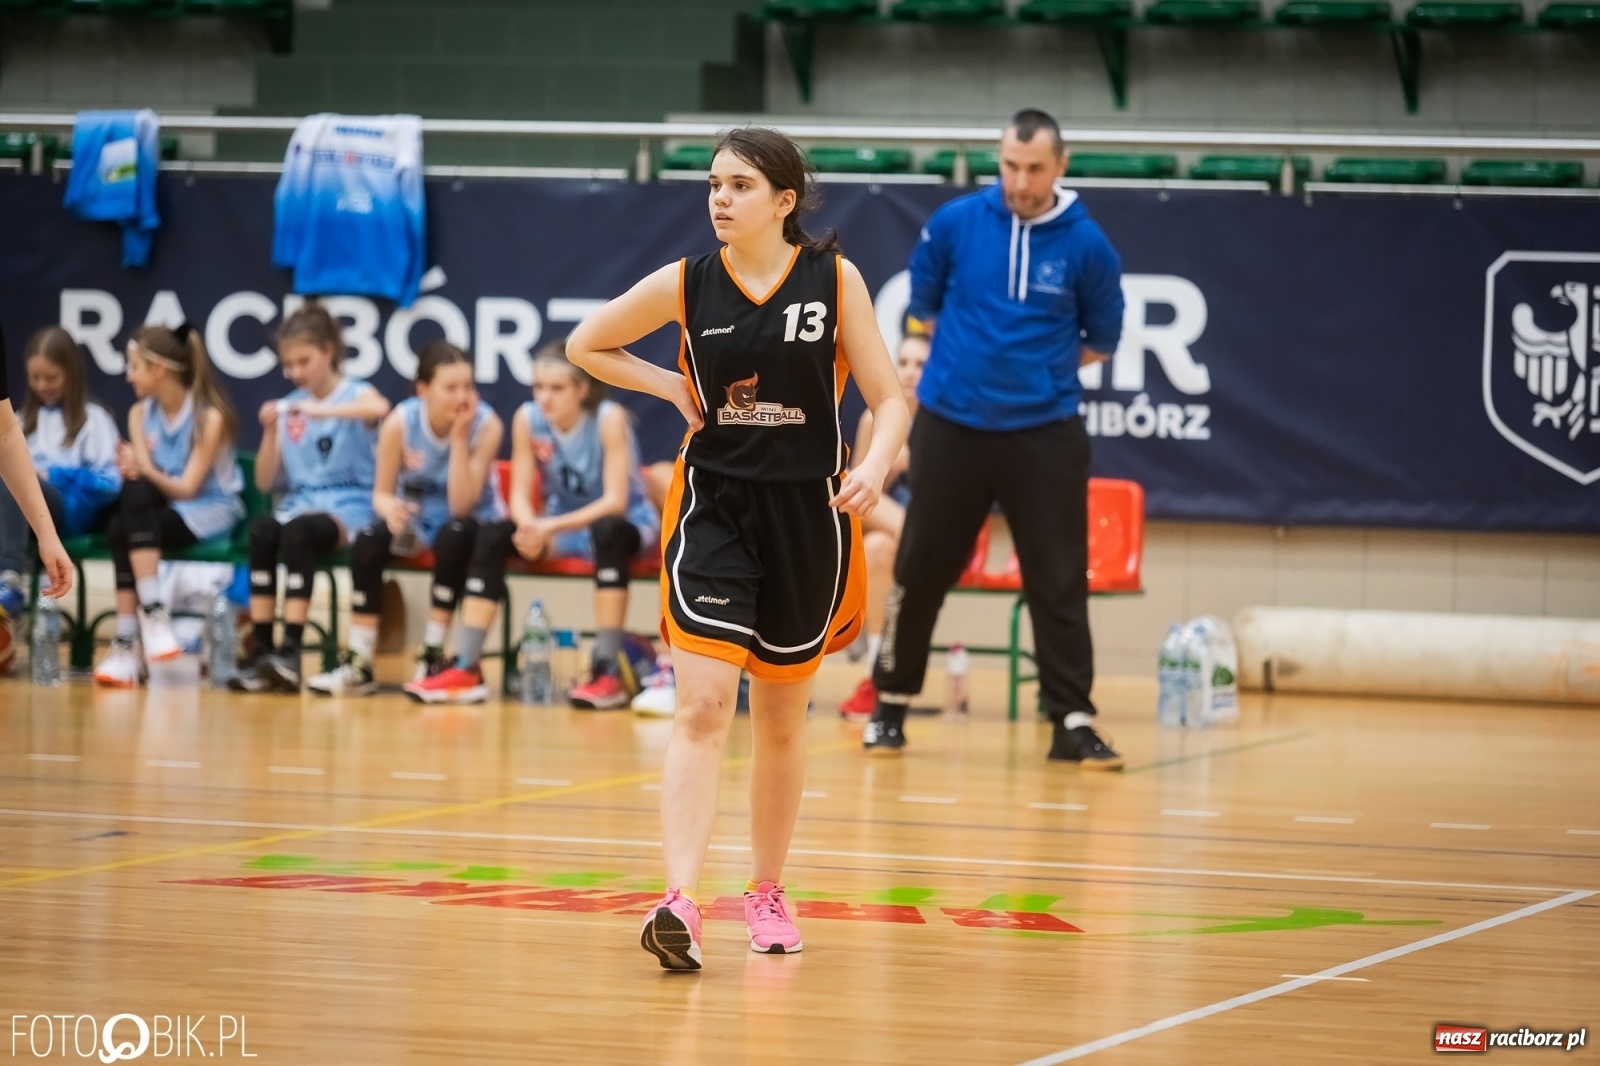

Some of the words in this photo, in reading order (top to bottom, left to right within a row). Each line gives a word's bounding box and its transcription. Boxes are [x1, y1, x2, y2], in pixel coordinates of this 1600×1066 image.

[60, 264, 611, 386] RCBÓR
[782, 301, 828, 342] 13
[722, 411, 803, 422] BASKETBALL
[1078, 392, 1212, 440] IBÓRZ
